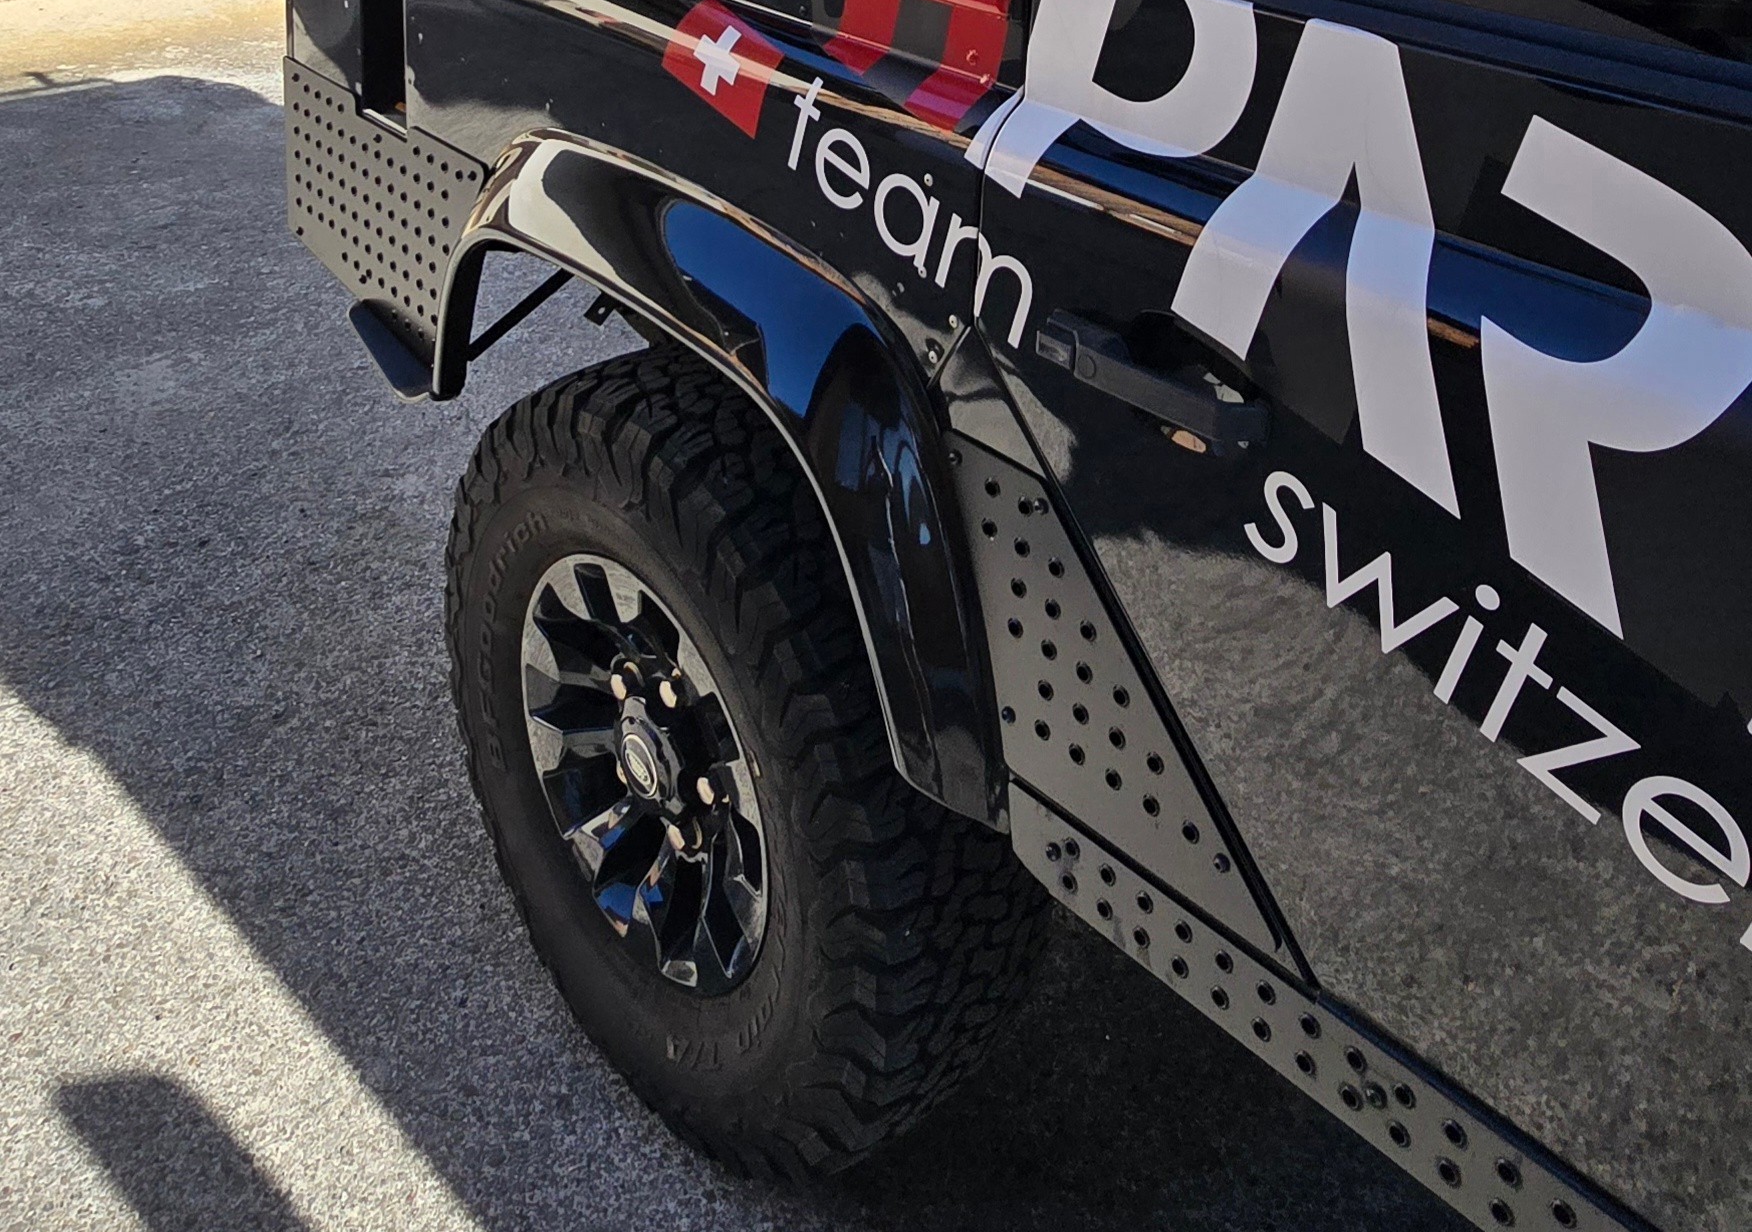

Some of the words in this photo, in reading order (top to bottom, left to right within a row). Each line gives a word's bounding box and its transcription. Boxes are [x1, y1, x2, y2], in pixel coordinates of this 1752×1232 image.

[477, 510, 549, 771] BFGoodrich
[788, 76, 1033, 349] team
[1244, 471, 1752, 952] switze
